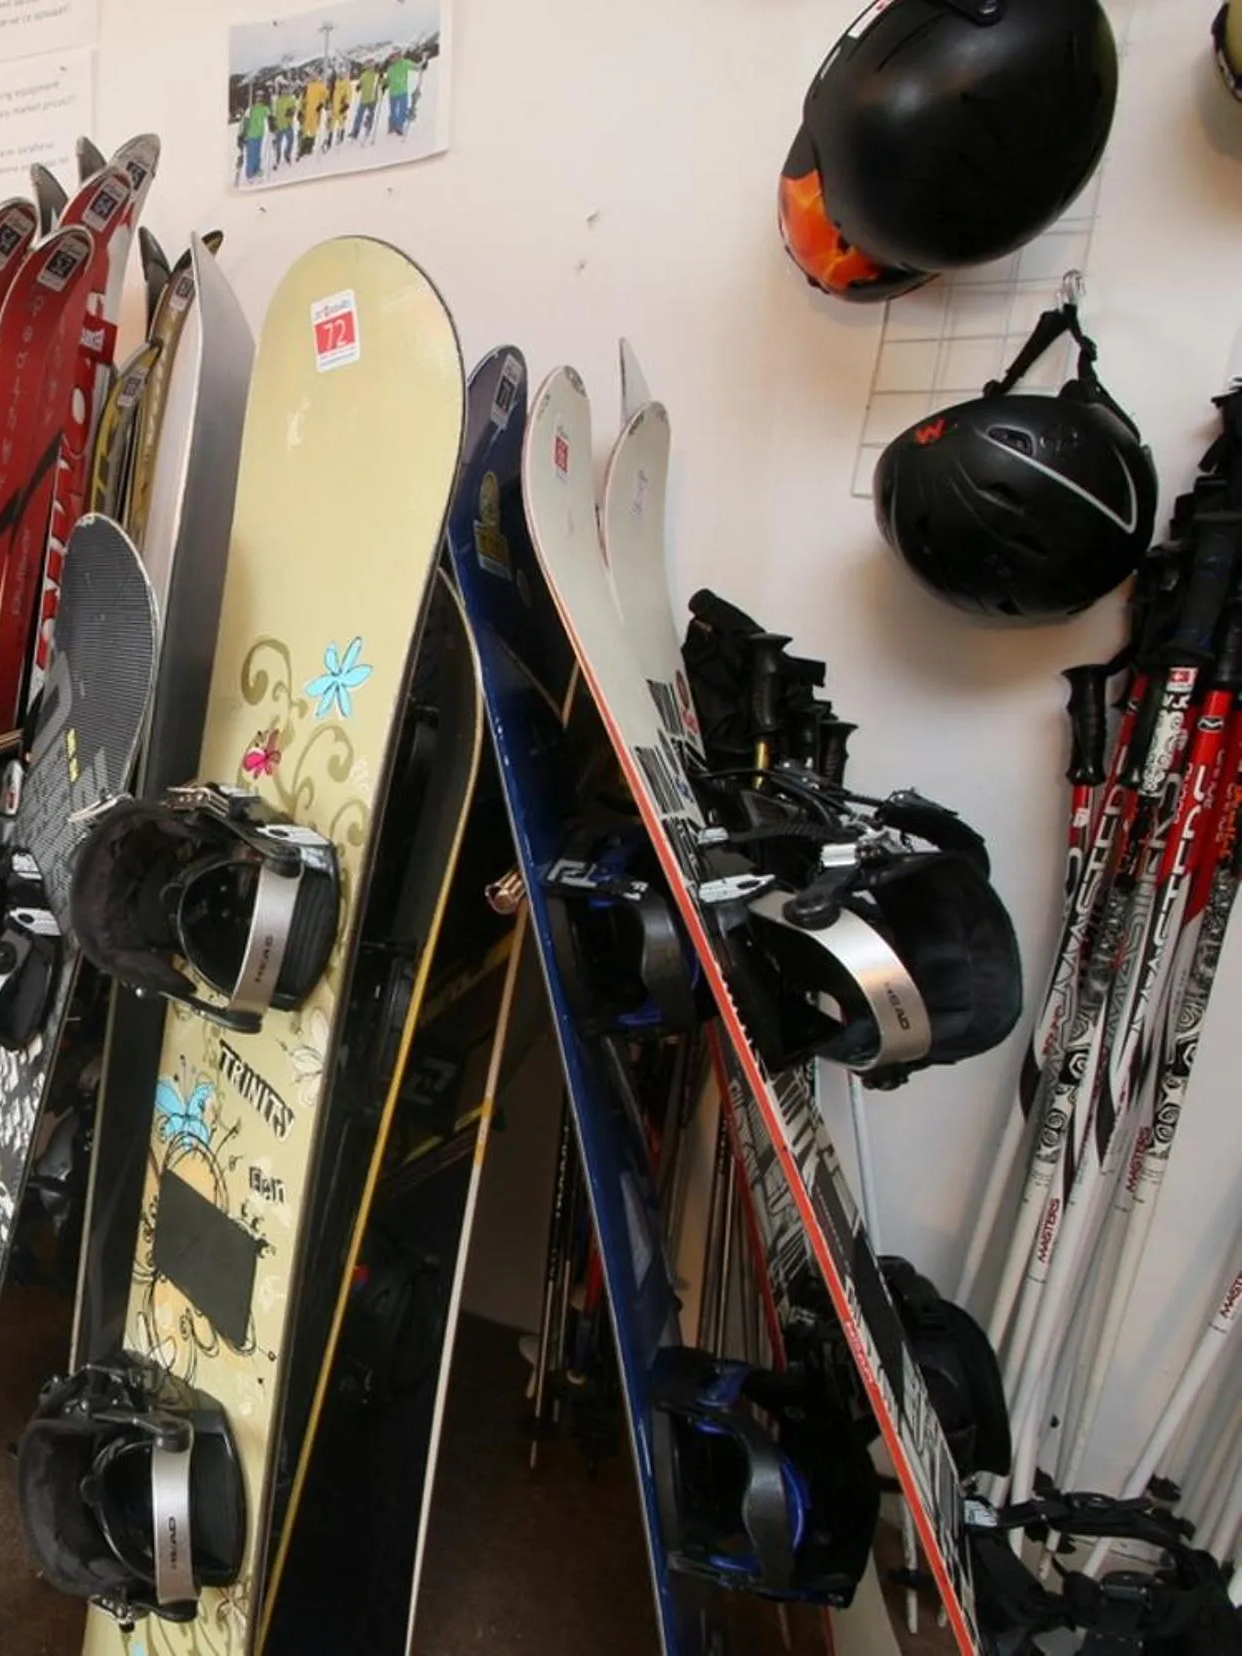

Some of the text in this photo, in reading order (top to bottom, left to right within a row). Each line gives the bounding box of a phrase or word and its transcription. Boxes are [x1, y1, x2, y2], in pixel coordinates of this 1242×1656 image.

[323, 319, 347, 351] 72
[252, 935, 275, 983] HEAD
[884, 982, 911, 1032] HEAD
[218, 1038, 296, 1145] TRINITY
[1126, 1126, 1152, 1194] MASTERS
[1036, 1197, 1060, 1264] MASTERS
[166, 1513, 179, 1572] HEAD
